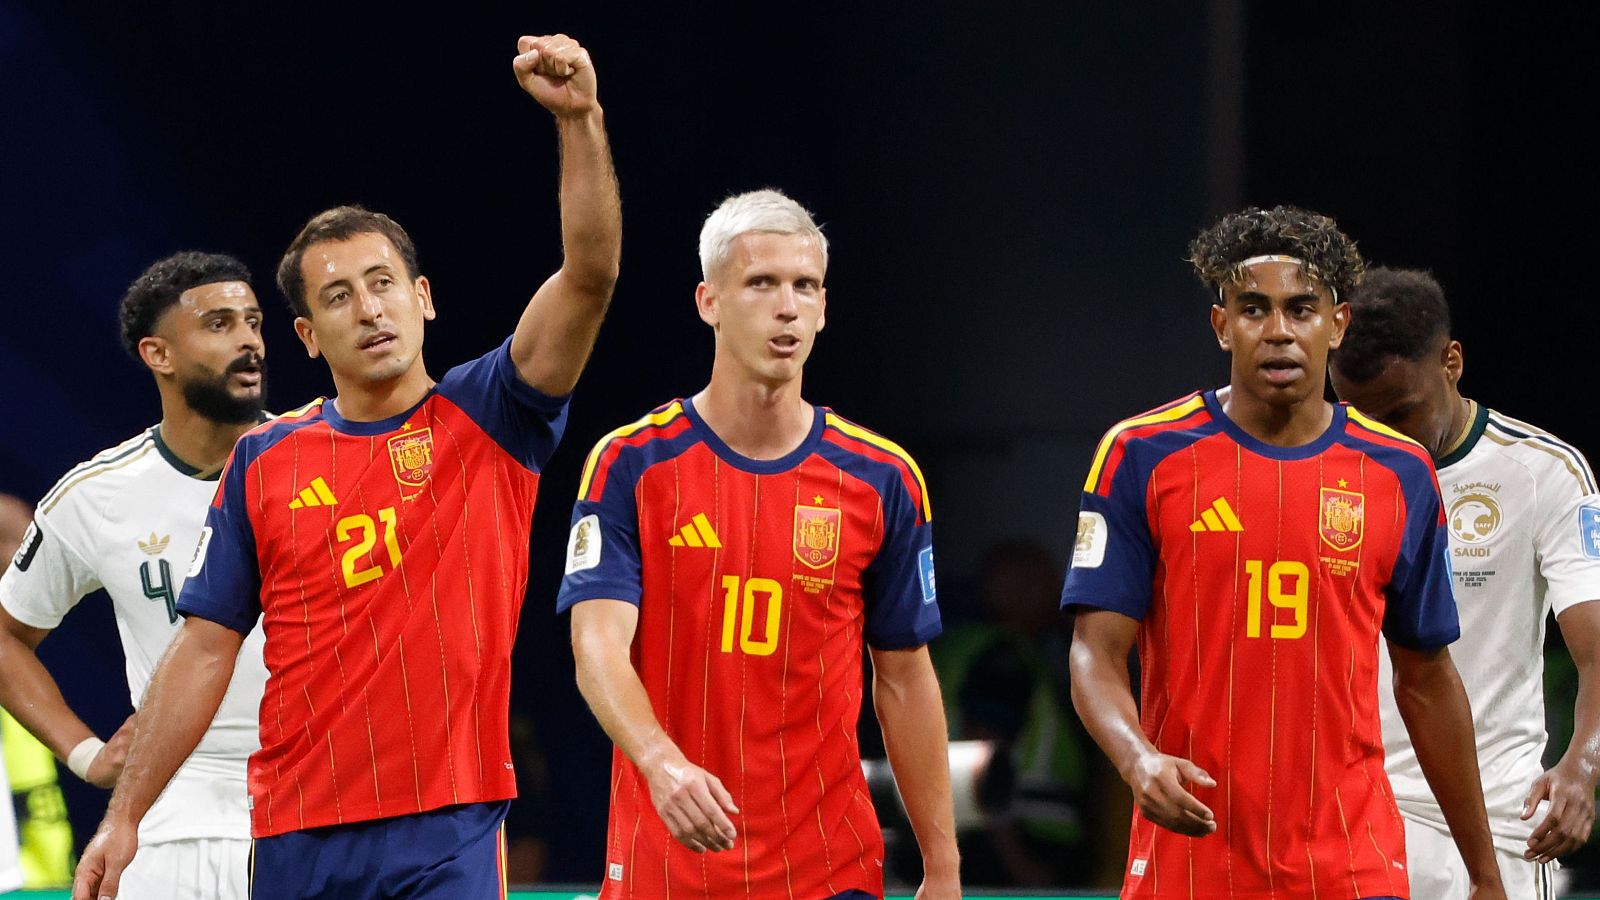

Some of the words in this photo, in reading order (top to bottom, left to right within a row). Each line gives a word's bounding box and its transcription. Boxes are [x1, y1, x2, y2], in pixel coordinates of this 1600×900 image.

[1453, 482, 1501, 494] السعودية
[336, 506, 402, 589] 21
[1454, 548, 1490, 557] SAUDI
[139, 558, 178, 624] 4
[721, 575, 783, 656] 10
[1245, 560, 1309, 639] 19
